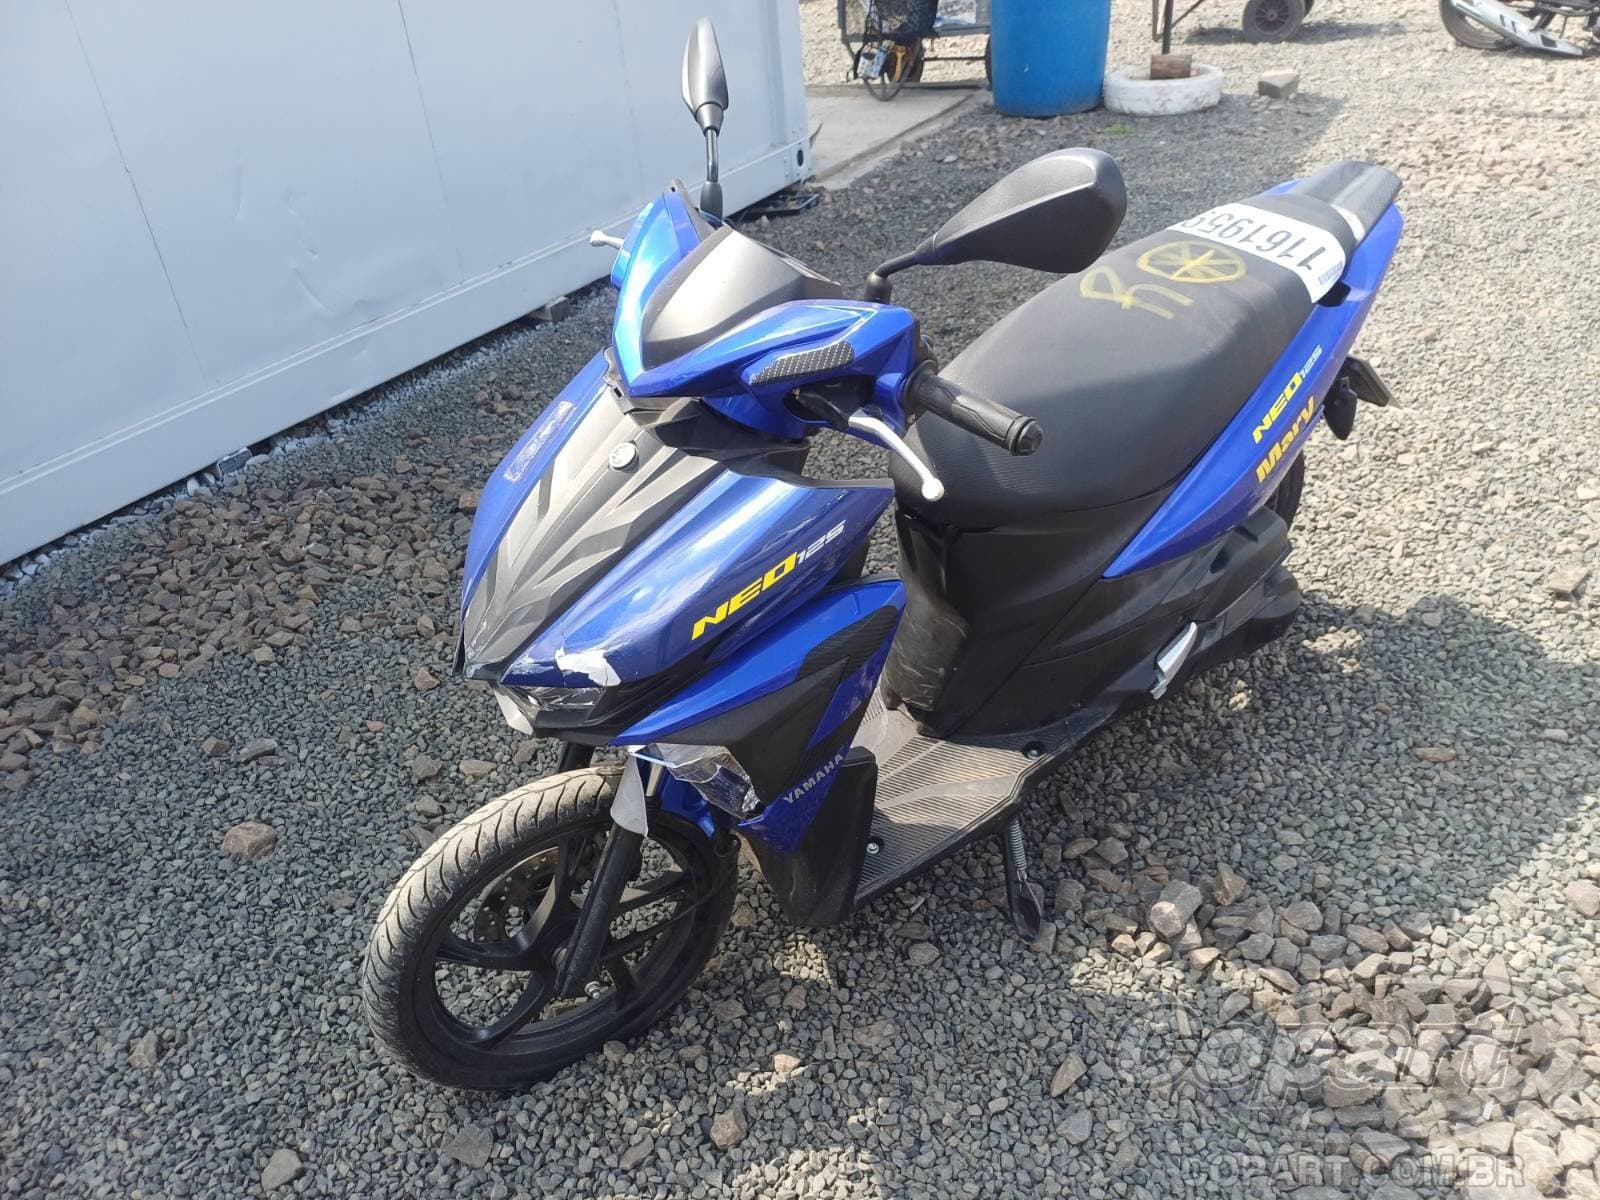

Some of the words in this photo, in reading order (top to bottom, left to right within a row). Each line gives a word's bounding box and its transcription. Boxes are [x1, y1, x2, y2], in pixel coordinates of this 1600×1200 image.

[1252, 371, 1303, 444] NEO
[1255, 395, 1314, 483] Mary
[691, 551, 798, 640] NEO
[796, 519, 846, 564] 125
[782, 753, 844, 804] YAMAHA
